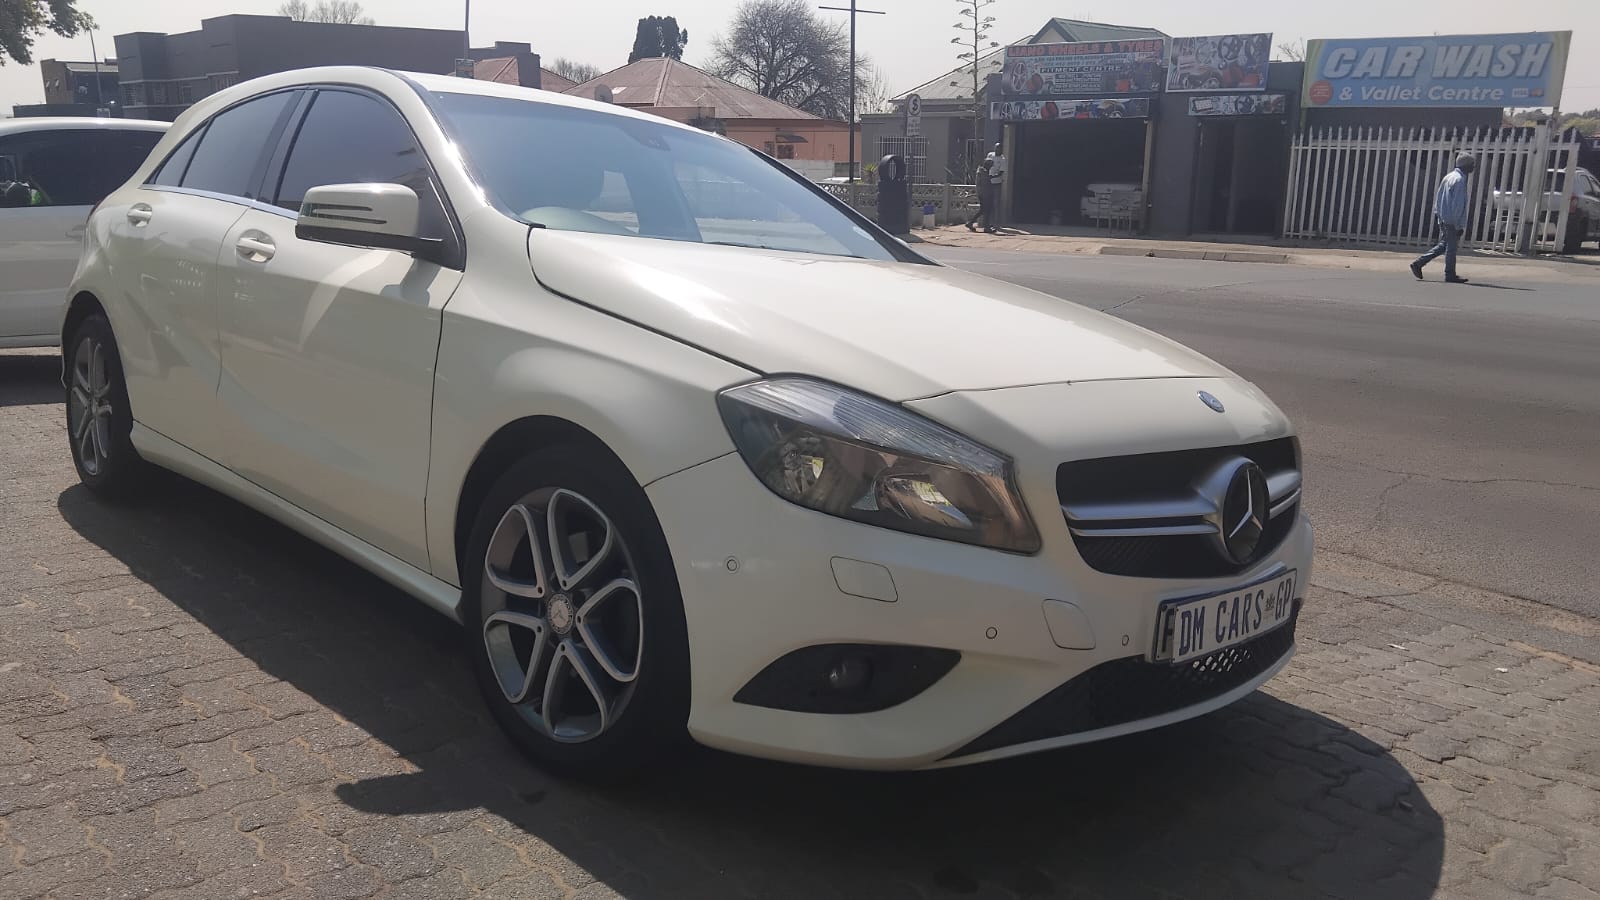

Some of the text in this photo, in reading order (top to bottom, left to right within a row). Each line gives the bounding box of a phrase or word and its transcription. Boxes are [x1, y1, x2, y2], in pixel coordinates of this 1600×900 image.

[1323, 42, 1552, 79] CAR WASH
[1338, 86, 1353, 101] &
[1361, 85, 1421, 101] Vallet
[1428, 85, 1504, 101] Centre
[1178, 577, 1292, 657] DM CARS GP
